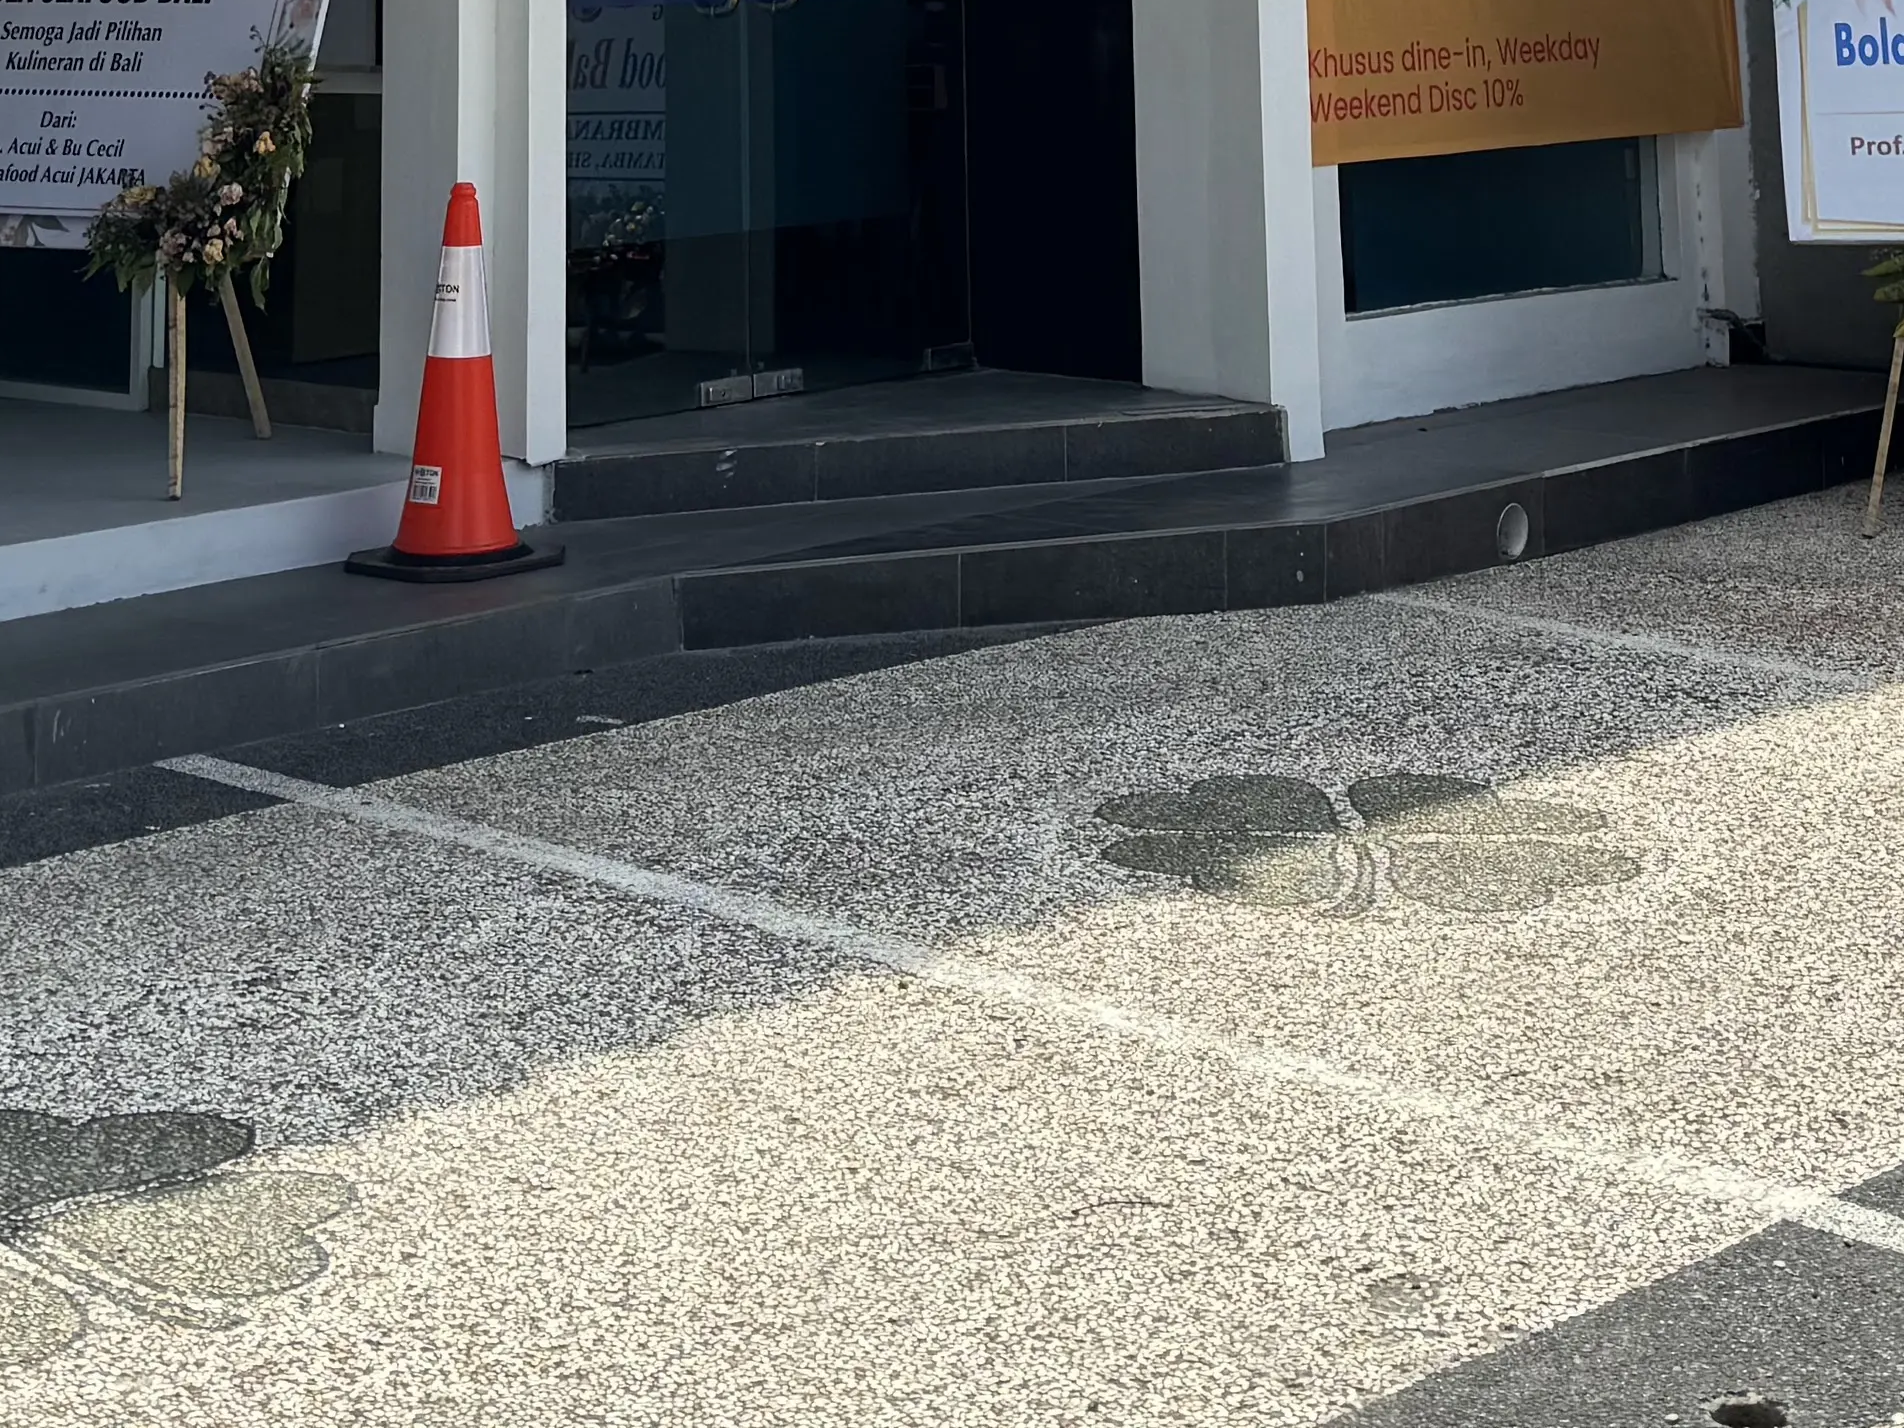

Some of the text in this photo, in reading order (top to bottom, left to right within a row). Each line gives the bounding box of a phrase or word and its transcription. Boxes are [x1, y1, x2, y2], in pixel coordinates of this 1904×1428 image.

[0, 20, 163, 46] Semoga Jadi Pilihan
[5, 50, 143, 73] Kulineran di Bali
[1309, 31, 1601, 79] Khusus dine-in, Weekday
[1310, 78, 1524, 123] Weekend Disc 10%
[40, 111, 77, 129] Dari:
[7, 137, 43, 155] Acui
[45, 139, 56, 156] &
[62, 140, 81, 157] Bu
[86, 139, 125, 158] Cecil
[40, 166, 77, 184] Acui
